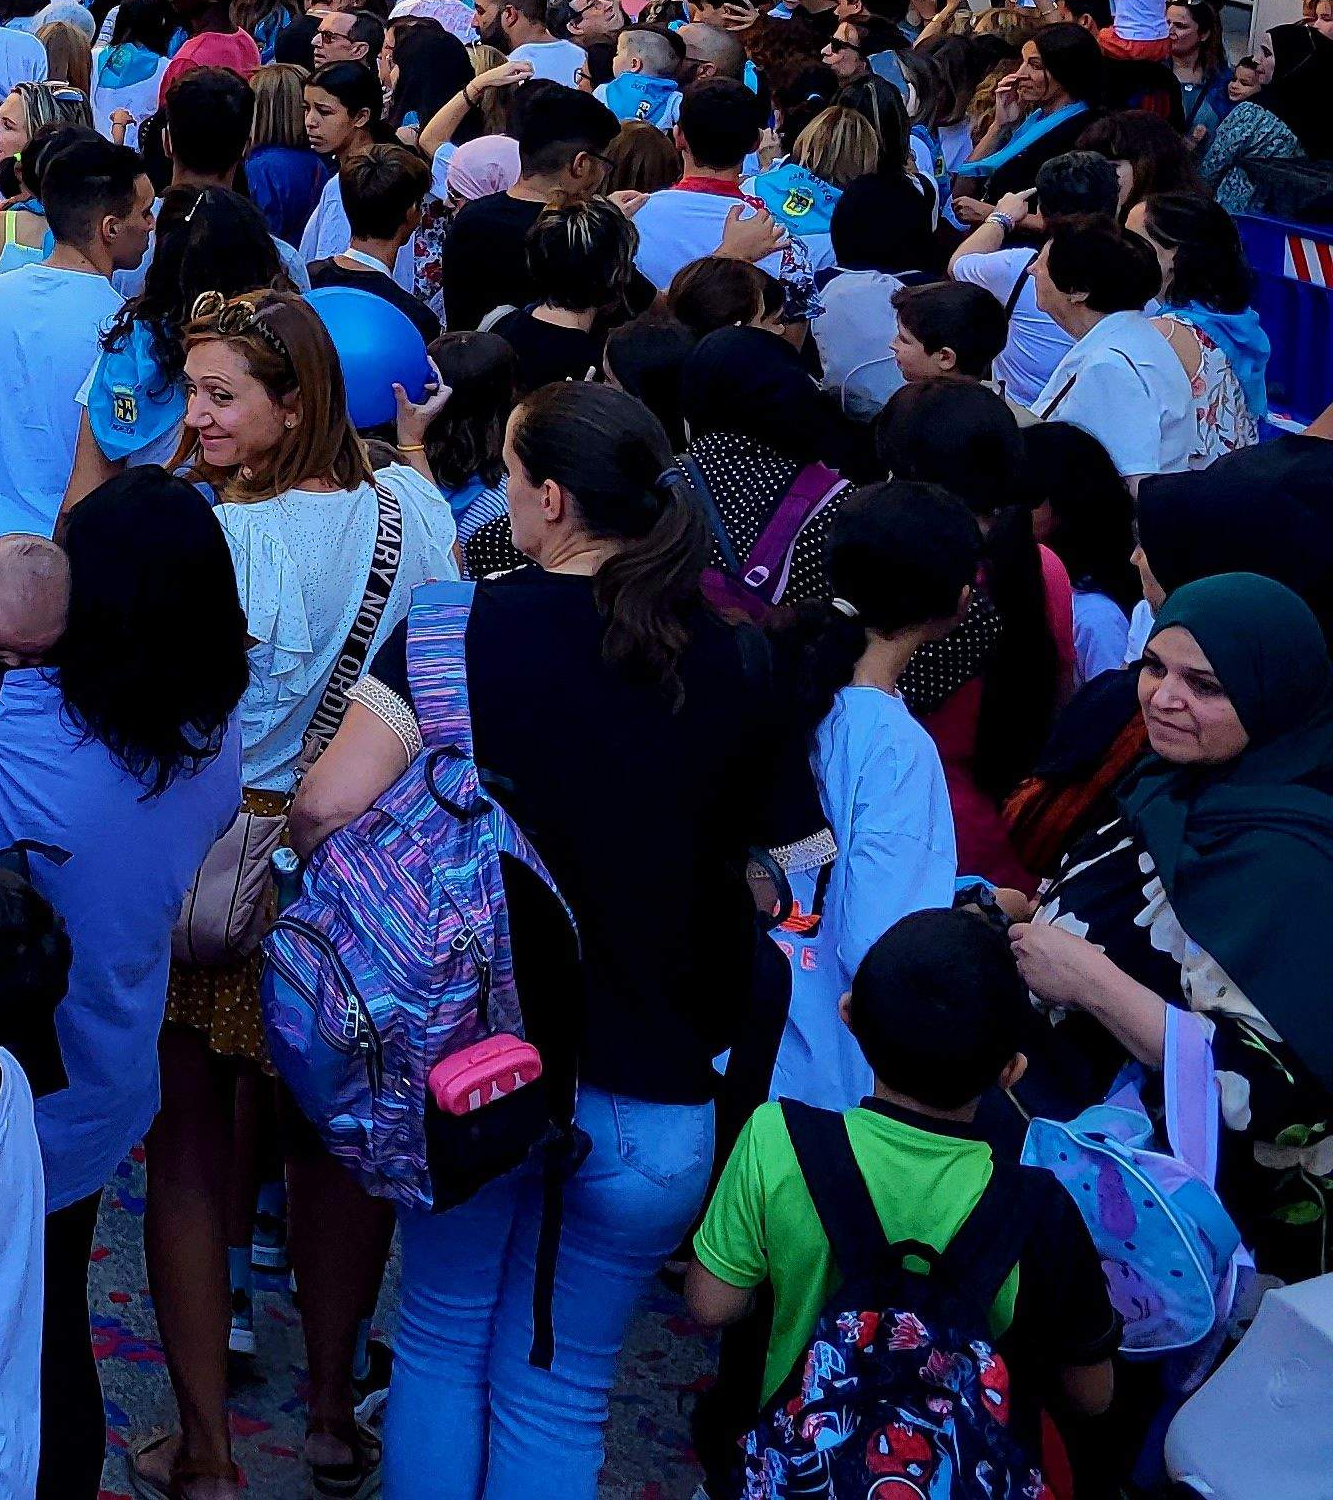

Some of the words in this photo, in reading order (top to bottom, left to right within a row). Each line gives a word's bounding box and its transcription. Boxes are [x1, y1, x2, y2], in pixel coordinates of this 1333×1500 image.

[372, 484, 401, 587] DINARY
[355, 591, 387, 651] NOT
[304, 654, 362, 747] ORDIN
